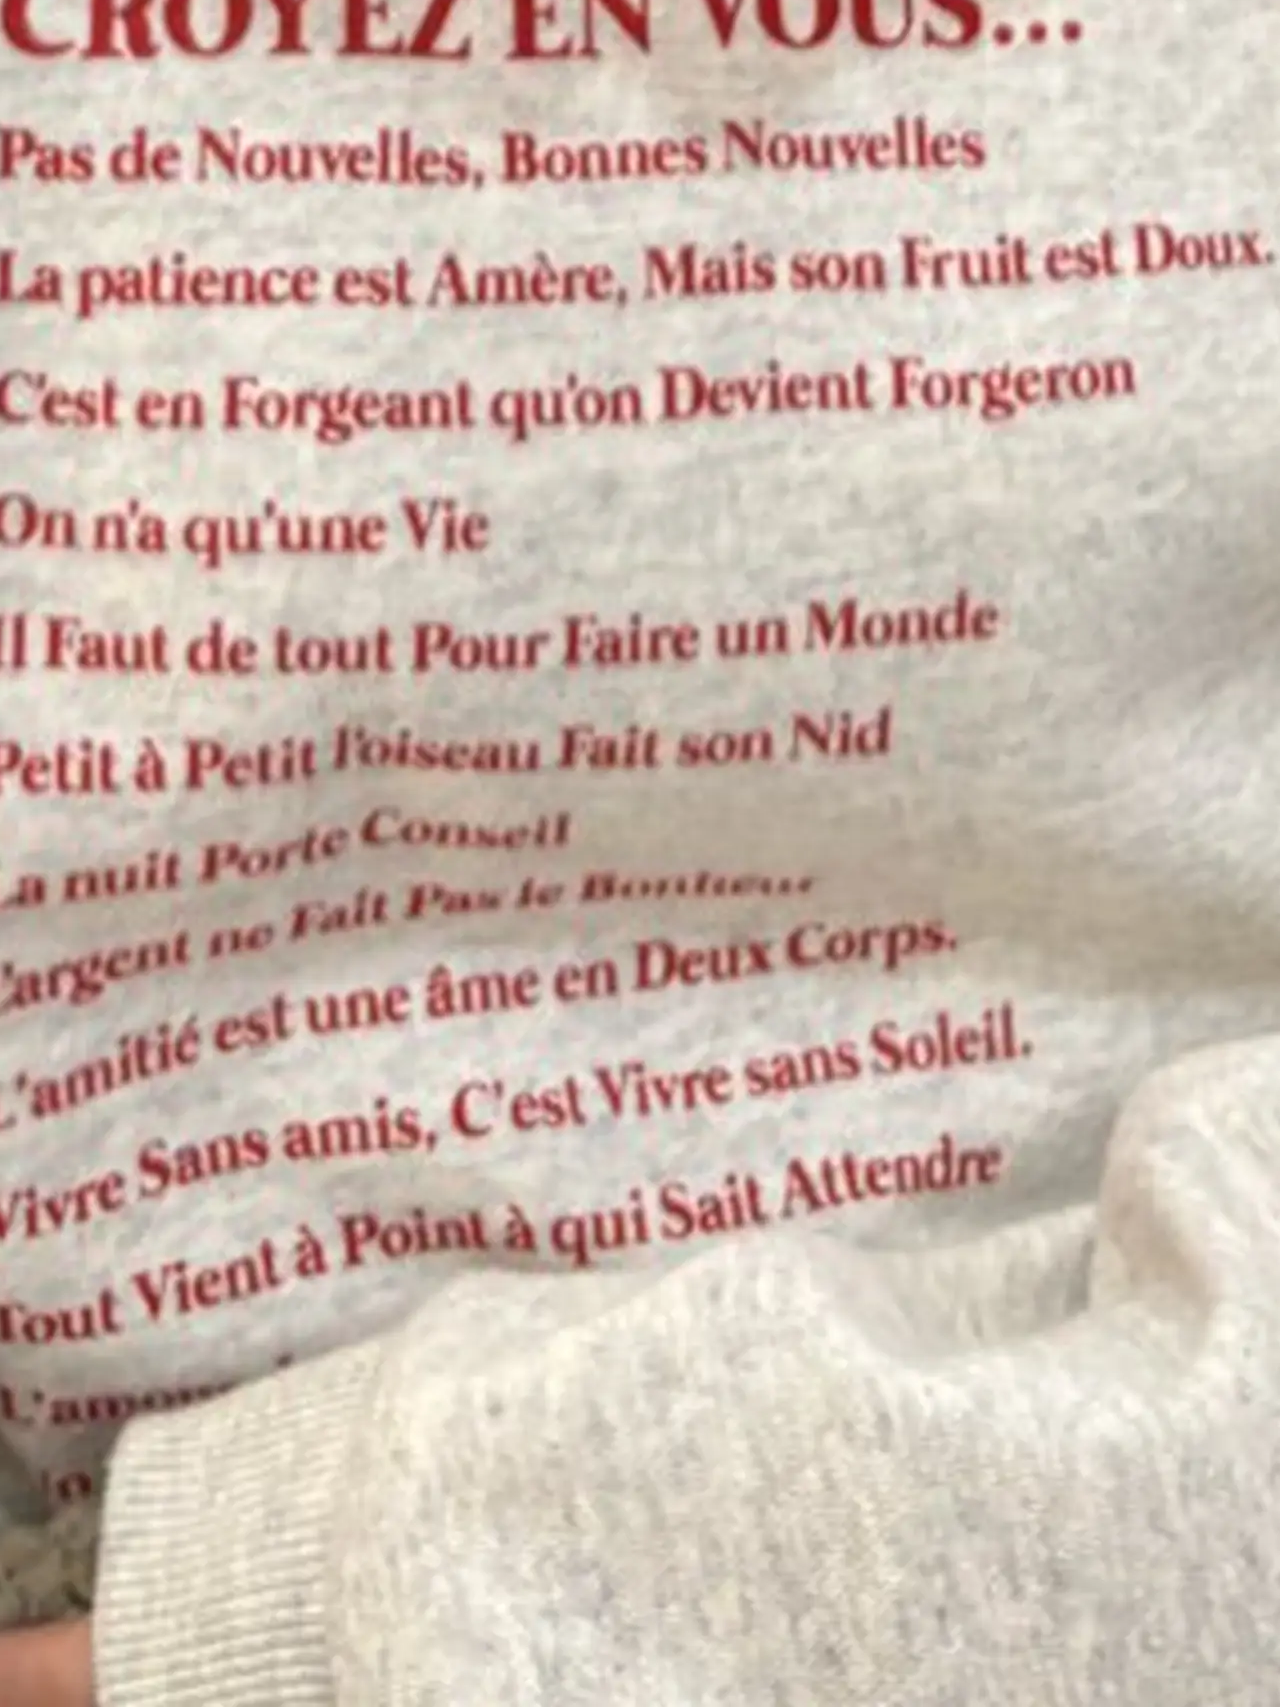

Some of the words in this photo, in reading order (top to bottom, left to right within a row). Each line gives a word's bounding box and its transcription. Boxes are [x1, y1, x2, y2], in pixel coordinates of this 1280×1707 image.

[109, 126, 181, 183] de
[197, 127, 485, 189] Nouvelles,
[501, 131, 709, 184] Bonnes
[720, 115, 986, 173] Nouvelles
[76, 251, 320, 321] patience
[333, 258, 415, 309] est
[427, 252, 628, 308] Amère,
[645, 241, 776, 299] Mais
[790, 253, 887, 292] son
[901, 233, 1033, 290] Fruit
[1044, 229, 1120, 283] est
[1134, 223, 1275, 275] Doux.
[135, 392, 205, 431] en
[223, 376, 476, 446] Forgeant
[489, 373, 644, 444] qu'on
[660, 360, 873, 422] Devient
[890, 356, 1136, 423] Forgeron
[92, 498, 168, 555] n'a
[182, 500, 388, 571] qu'une
[401, 498, 490, 554] Vie
[45, 616, 169, 673] Faut
[185, 620, 258, 677] de
[275, 627, 393, 675] tout
[412, 622, 550, 674] Pour
[562, 613, 700, 669] Faire
[716, 618, 789, 659] un
[805, 588, 999, 651] Monde
[133, 738, 167, 794] à
[185, 737, 319, 791] Petit
[332, 725, 540, 774] l'oiseau
[557, 725, 658, 770] Fait
[677, 730, 773, 767] son
[790, 706, 891, 759] Nid
[63, 851, 180, 904] nuit
[200, 827, 349, 884] Porte
[290, 894, 387, 941] Fait
[212, 998, 294, 1052] est
[304, 985, 410, 1035] une
[425, 964, 541, 1019] âme
[553, 959, 619, 1003] en
[633, 936, 773, 991] Deux
[785, 920, 958, 972] Corps.
[137, 1139, 270, 1198] Sans
[281, 1096, 439, 1163] amis,
[450, 1076, 587, 1140] C'est
[593, 1061, 731, 1118] Vivre
[743, 1043, 862, 1097] sans
[869, 1001, 1033, 1074] Soleil.
[131, 1244, 282, 1320] Vient
[294, 1224, 328, 1279] à
[340, 1206, 489, 1267] Point
[503, 1203, 537, 1255] à
[550, 1191, 651, 1265] qui
[658, 1173, 769, 1241] Sait
[781, 1134, 1002, 1219] Attendre
